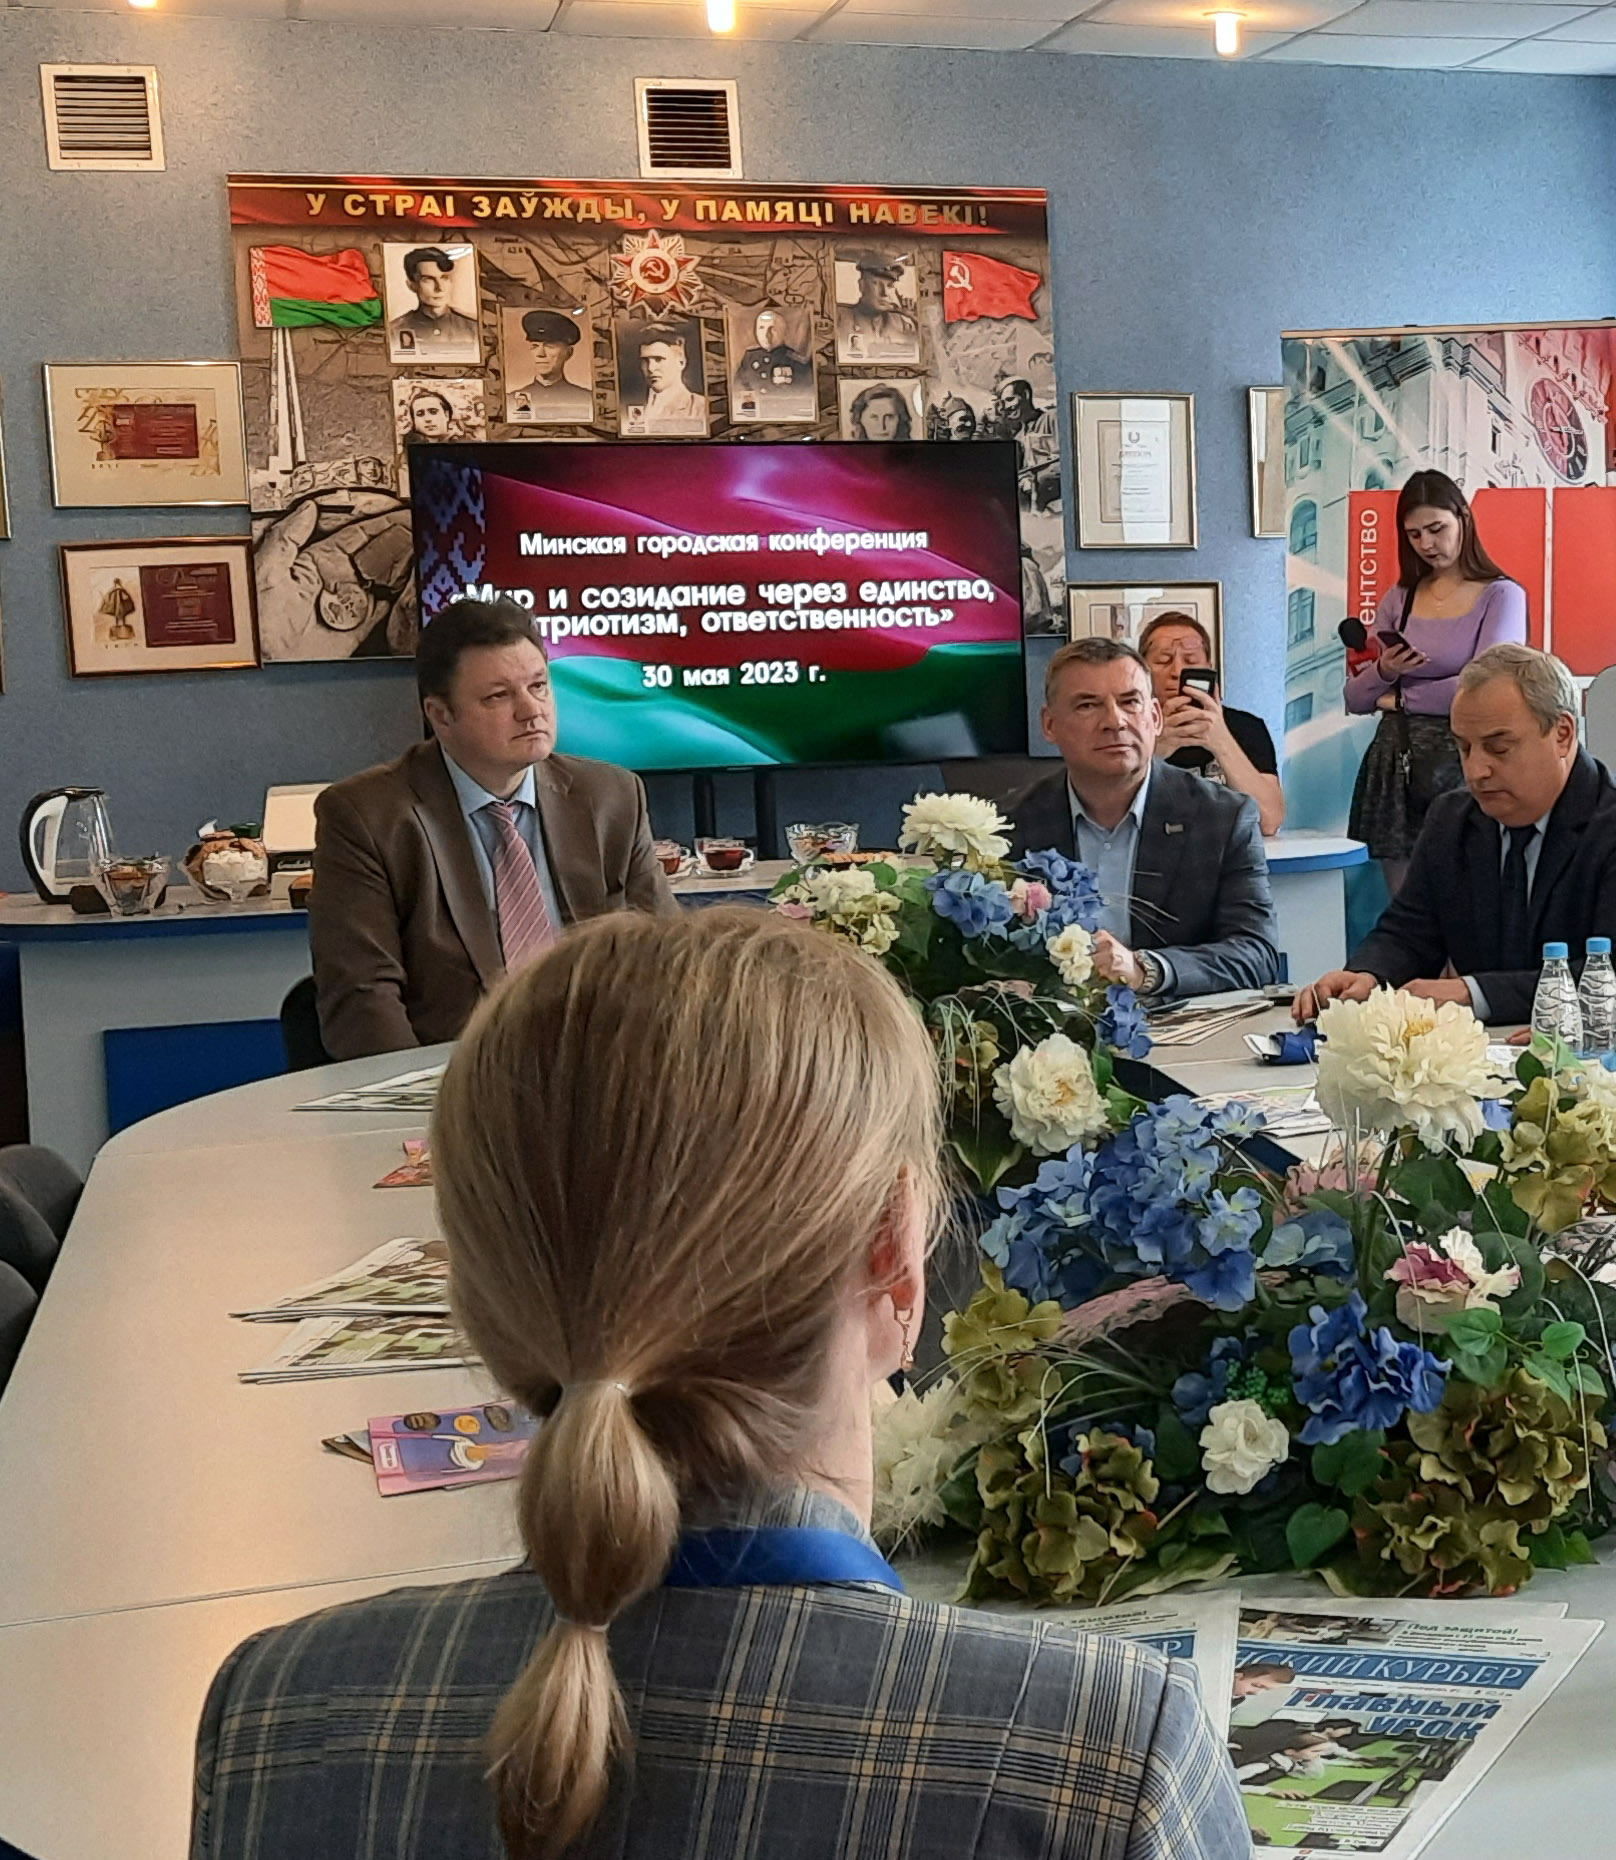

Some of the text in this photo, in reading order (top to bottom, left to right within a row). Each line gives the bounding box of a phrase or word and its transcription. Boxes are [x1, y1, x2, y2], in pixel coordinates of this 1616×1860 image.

[306, 190, 989, 227] У СТРАІ ЗАЎЖДЫ, У ПАМЯЦІ НАВЕКІ!
[519, 526, 928, 559] Минская городская конференция
[1359, 508, 1379, 626] ентство
[547, 588, 569, 610] и
[581, 584, 746, 611] созидание
[758, 581, 847, 610] через
[858, 579, 995, 604] единство,
[535, 606, 954, 645] триотизм, ответственность»
[642, 661, 827, 689] 30 мая 2023 г.
[1368, 1658, 1523, 1686] КУРЬЕР
